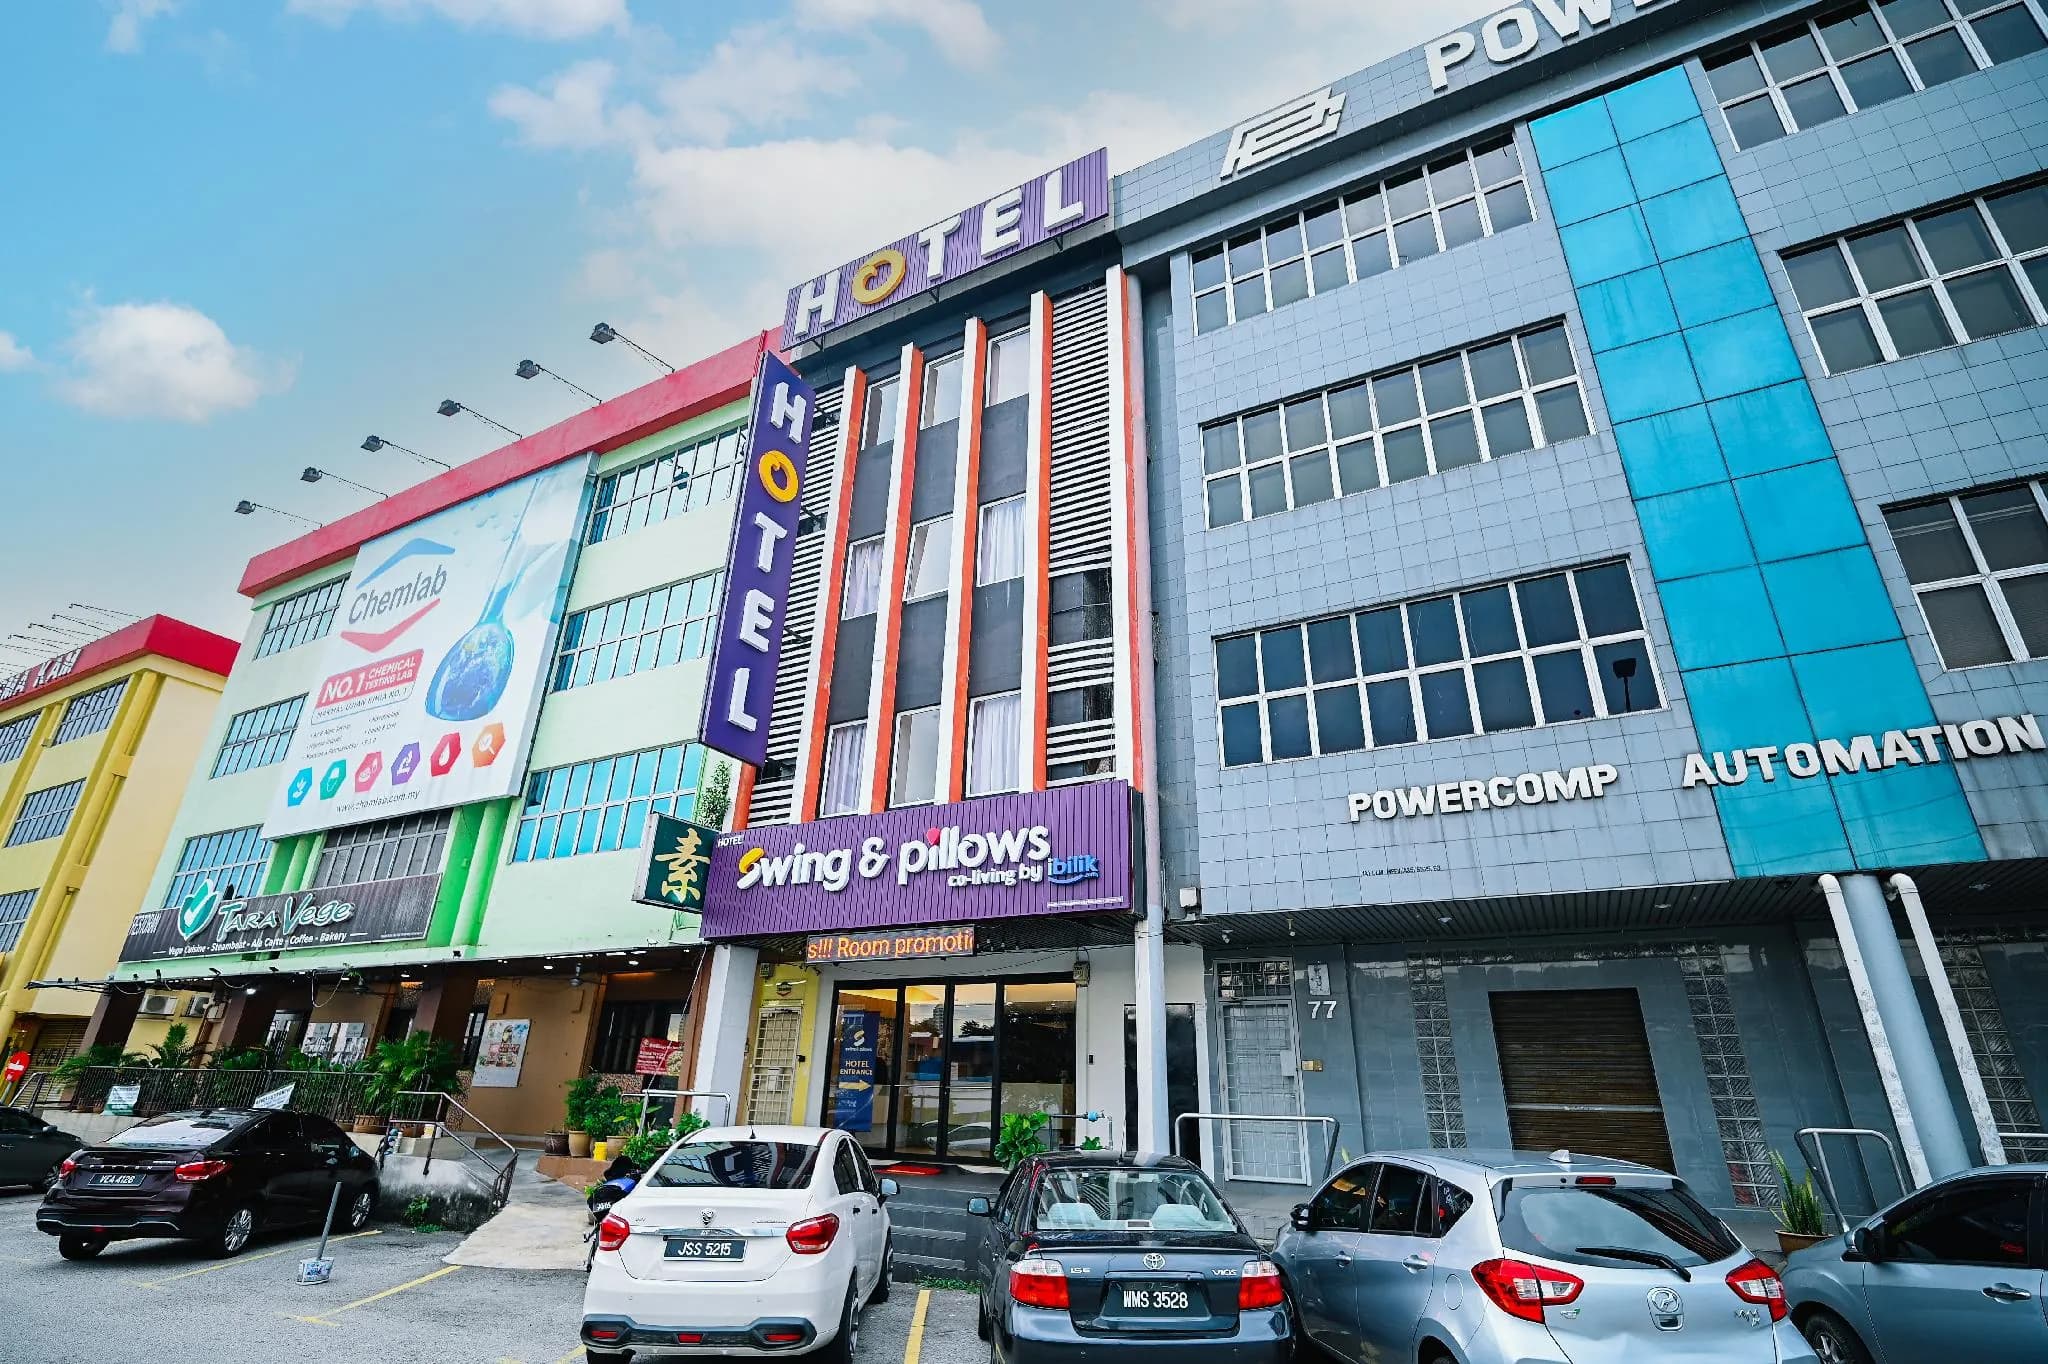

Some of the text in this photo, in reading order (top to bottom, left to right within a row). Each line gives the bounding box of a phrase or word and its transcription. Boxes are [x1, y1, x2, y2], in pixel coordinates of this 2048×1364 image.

[1424, 0, 1658, 92] POW
[794, 169, 1085, 337] HOTEL
[727, 381, 806, 732] HOTEL
[349, 565, 447, 624] Chemlab
[368, 656, 416, 679] CHEMICAL
[395, 669, 413, 682] LAB
[1348, 714, 2047, 823] POWERCOMP AUTOMATION
[717, 834, 745, 848] HOTEL
[655, 828, 711, 903] 素
[737, 825, 1051, 892] Swing & pillows
[947, 854, 1099, 887] co-living by ibilik
[282, 893, 356, 936] Vege
[290, 933, 314, 945] Coffee
[320, 931, 348, 942] Bakery
[837, 936, 890, 958] Room
[1307, 1000, 1337, 1019] 77
[840, 1068, 872, 1076] ENTRANCE
[845, 1060, 870, 1068] HOTEL
[678, 1241, 732, 1256] JSS 5215
[1123, 1290, 1189, 1309] WMS 3528
